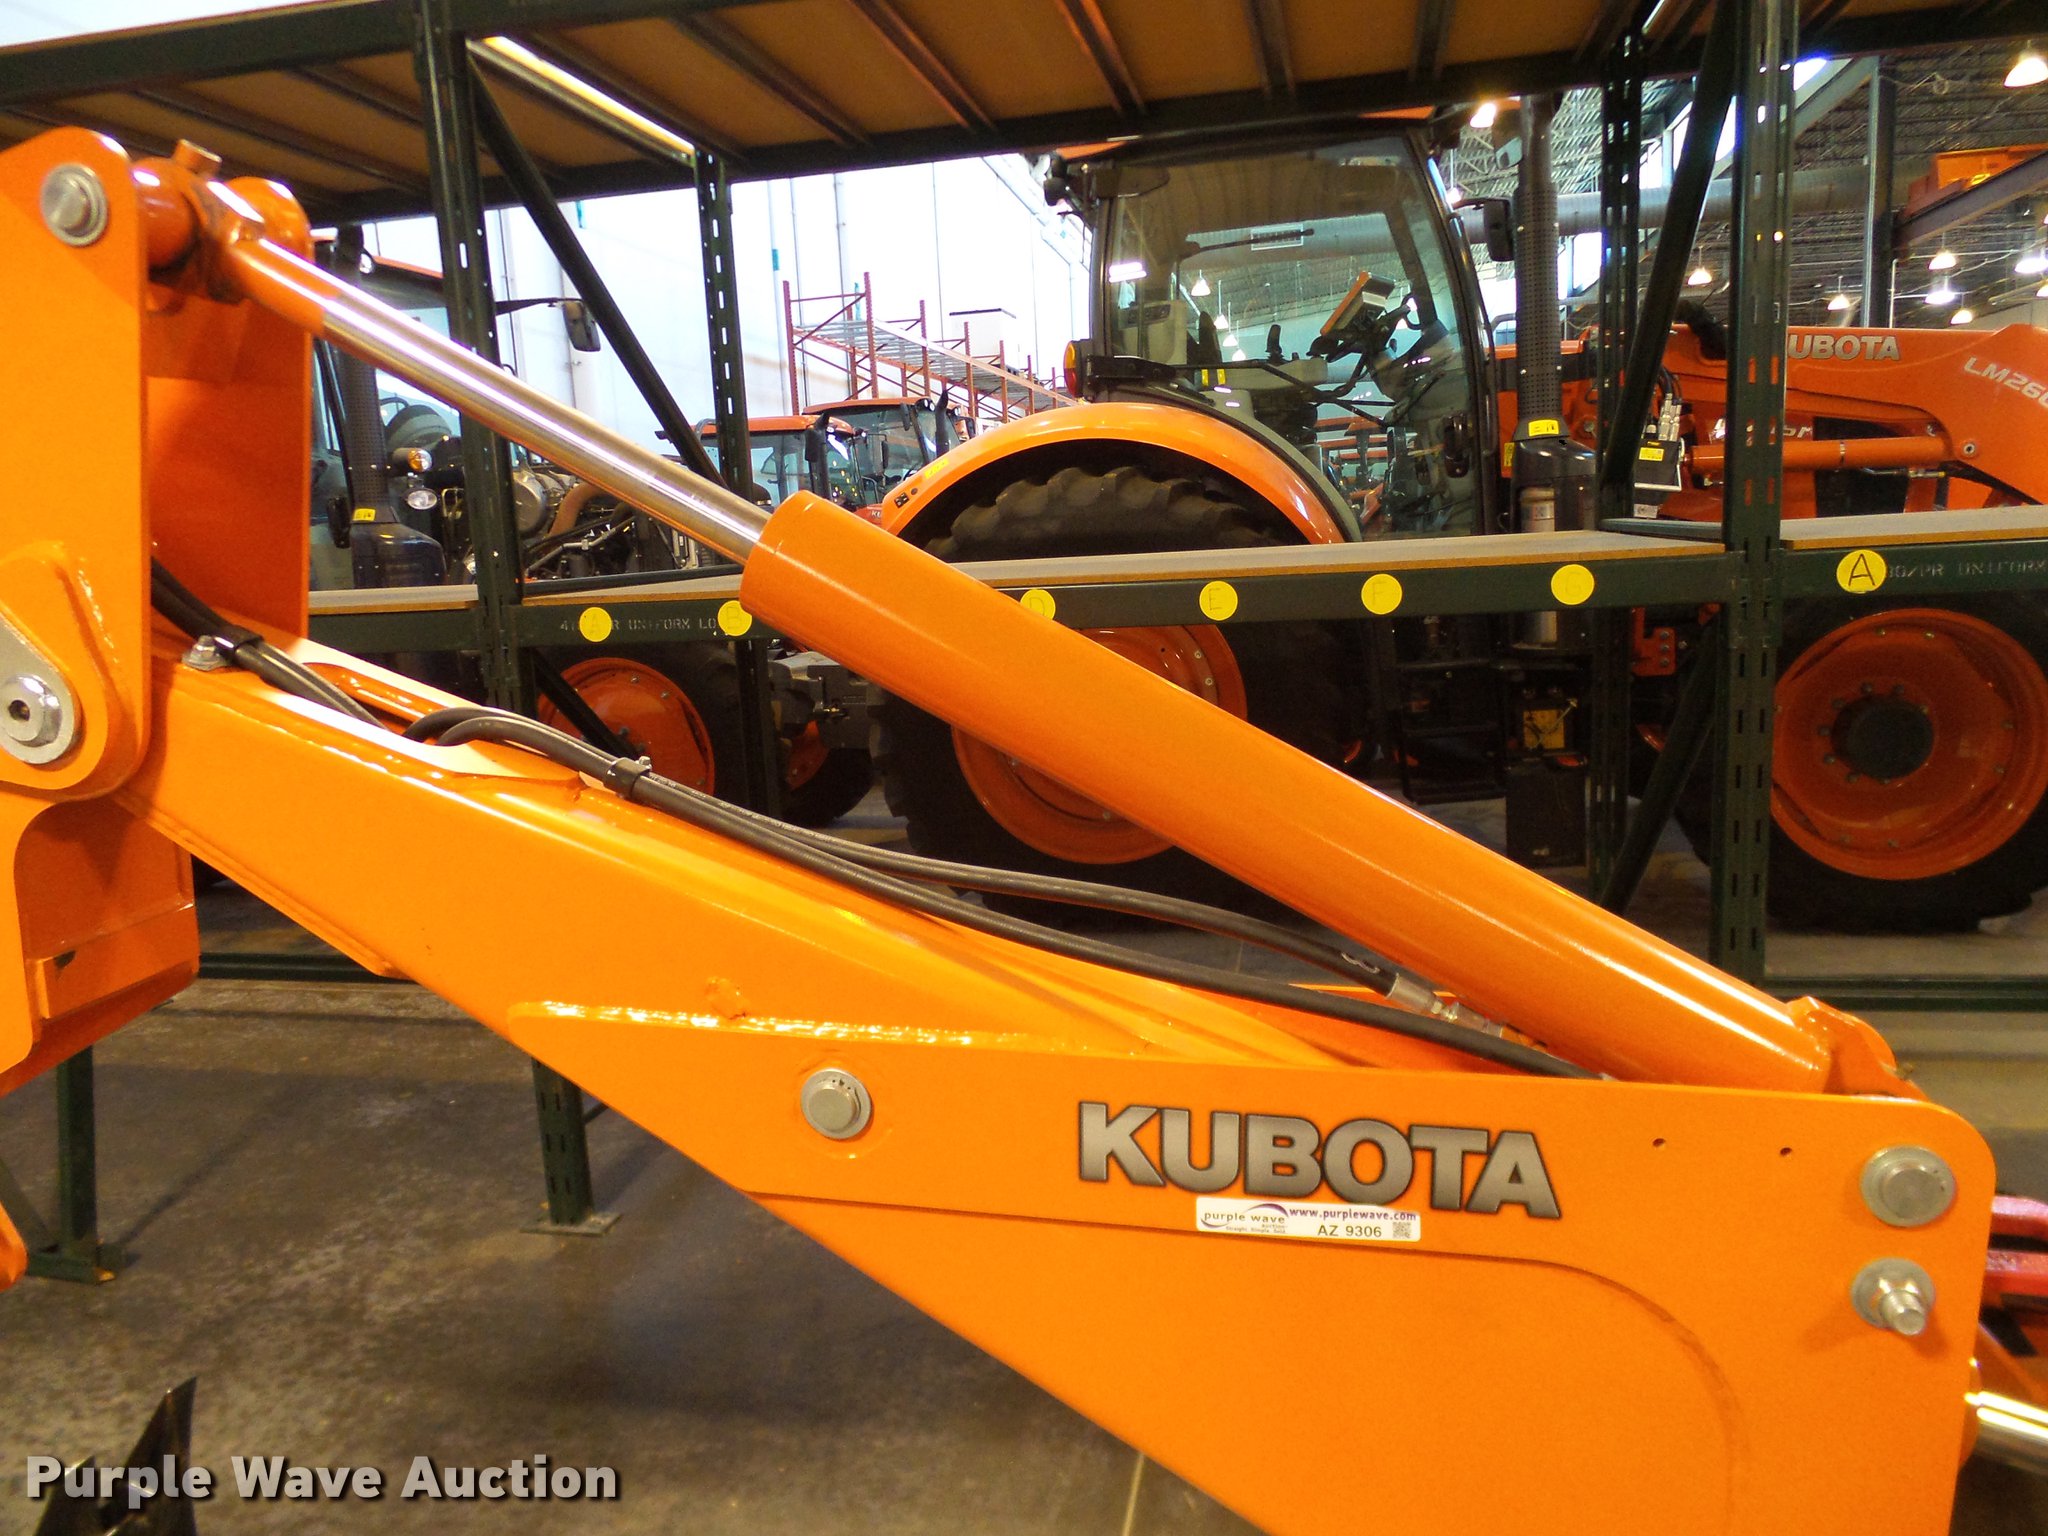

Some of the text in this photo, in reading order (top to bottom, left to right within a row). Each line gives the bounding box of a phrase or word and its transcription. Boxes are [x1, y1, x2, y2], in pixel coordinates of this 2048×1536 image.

[1787, 333, 1900, 360] UBOTA
[1847, 553, 1876, 586] A
[1208, 587, 1223, 611] E
[1079, 1101, 1562, 1219] KUBOTA
[1204, 1212, 1285, 1224] purple wave
[1288, 1207, 1417, 1221] www.purplewave.com
[1317, 1224, 1382, 1238] AZ 9306
